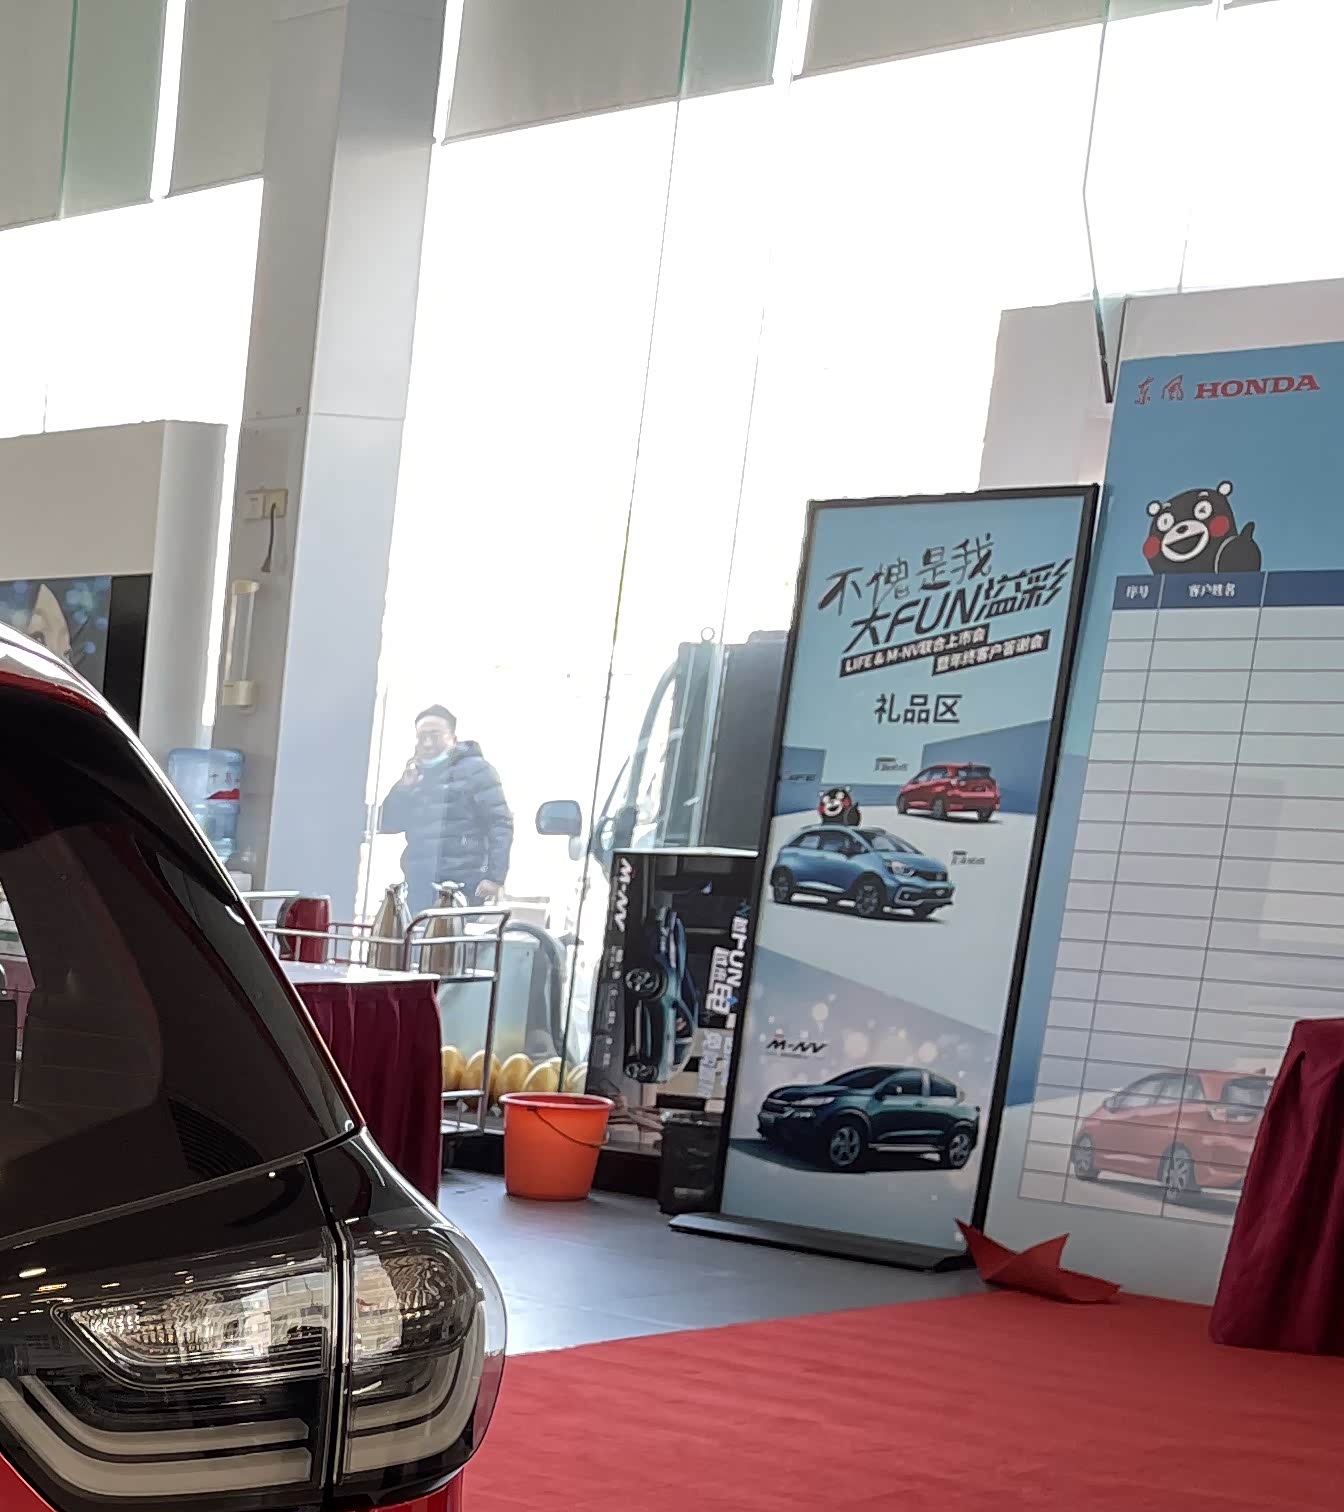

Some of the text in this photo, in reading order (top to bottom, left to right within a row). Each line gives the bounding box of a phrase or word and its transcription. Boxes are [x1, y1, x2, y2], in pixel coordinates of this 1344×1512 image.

[1194, 374, 1320, 399] HONDA
[818, 532, 995, 616] 不愧是我
[874, 693, 963, 725] 礼品区
[766, 1039, 828, 1054] M-NV
